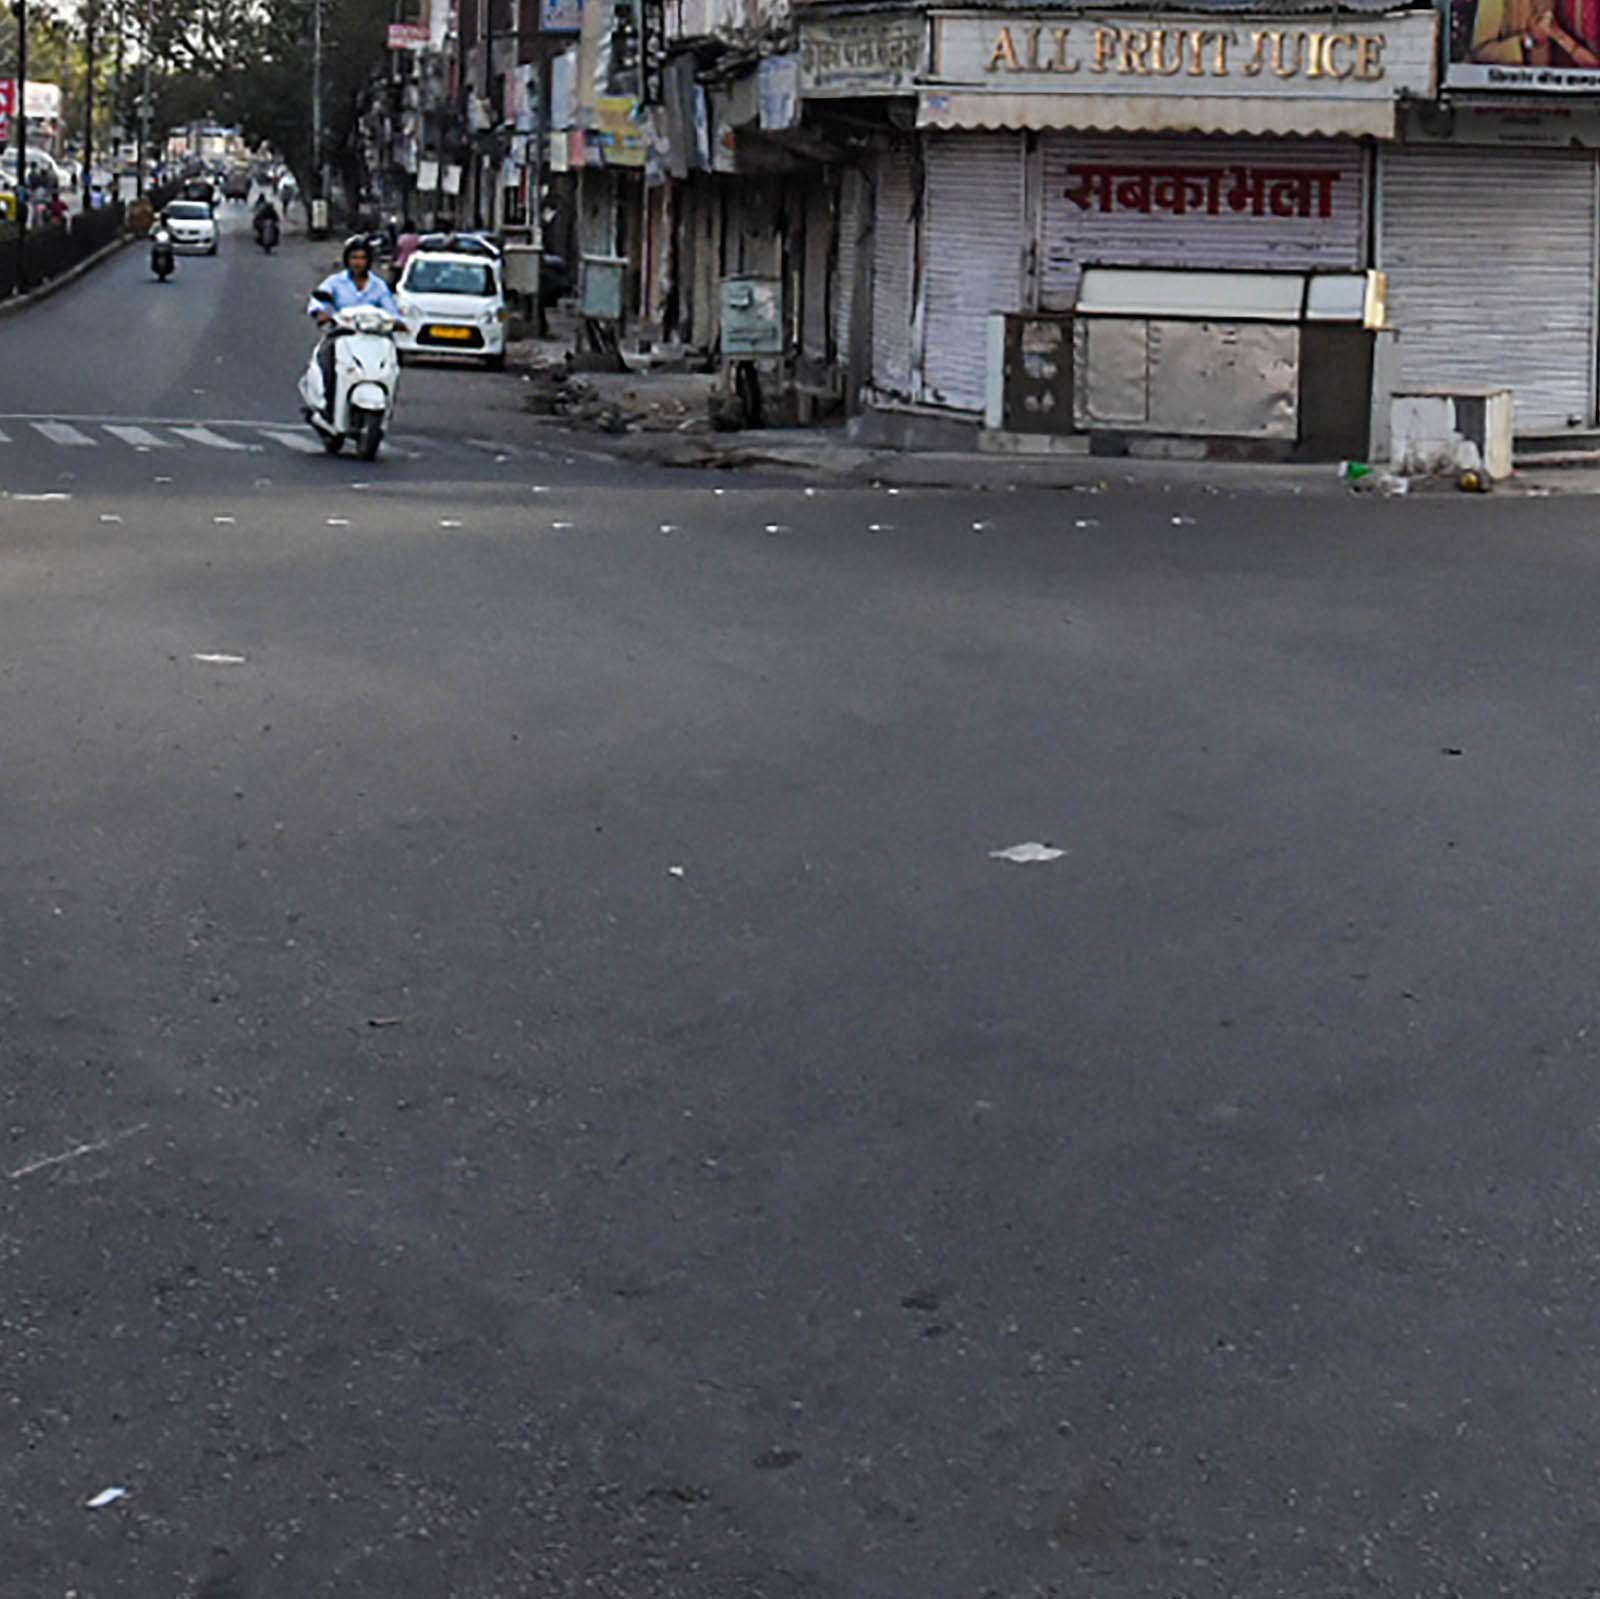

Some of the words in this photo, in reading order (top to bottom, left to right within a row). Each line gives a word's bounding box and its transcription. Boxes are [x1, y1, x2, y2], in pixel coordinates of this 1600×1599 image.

[985, 25, 1080, 74] ALL
[1093, 27, 1228, 79] FRUIT
[1244, 30, 1386, 82] JUICE
